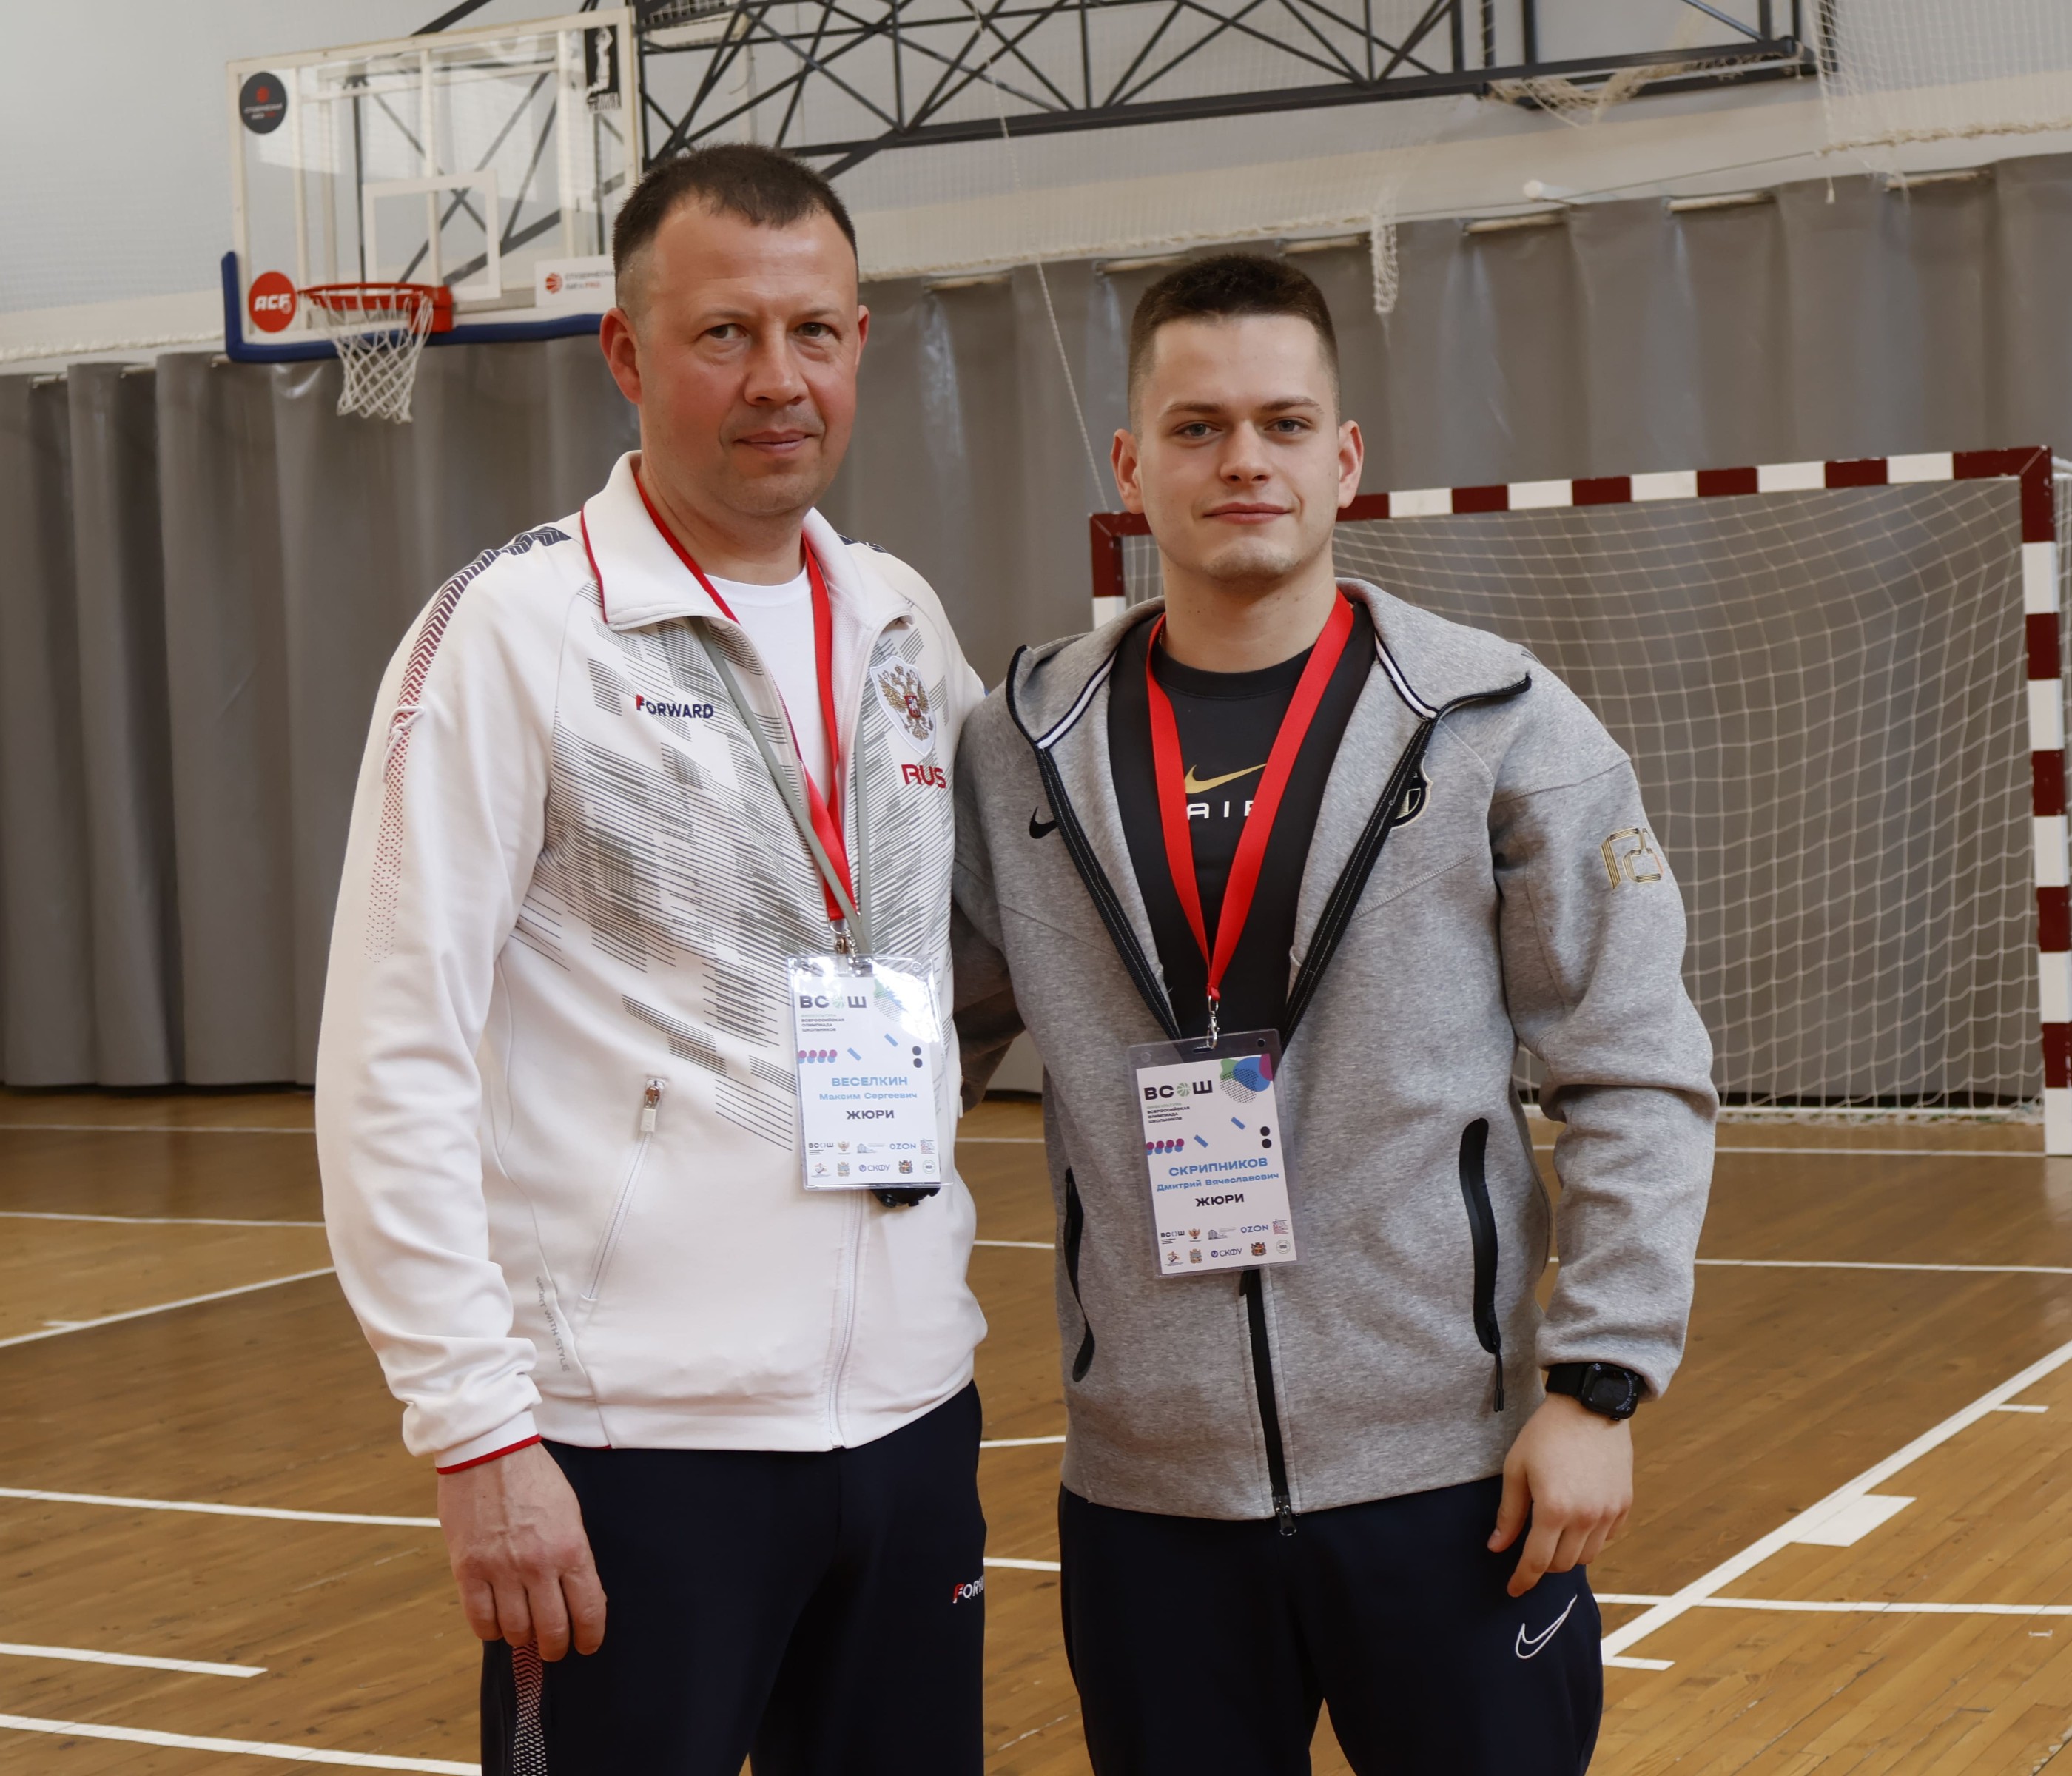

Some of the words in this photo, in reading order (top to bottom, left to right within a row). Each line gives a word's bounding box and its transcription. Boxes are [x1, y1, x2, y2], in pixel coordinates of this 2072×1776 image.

[636, 694, 714, 719] FORWARD
[901, 764, 946, 789] RUS
[831, 1077, 908, 1086] ВЕСЕЛКИН
[864, 1092, 918, 1100] Сергеевич
[846, 1109, 895, 1120] ЖЮРИ
[1168, 1157, 1268, 1177] СКРИПНИКОВ
[1156, 1180, 1202, 1192] Дмитрий
[1205, 1173, 1279, 1186] Вячеславович
[1195, 1194, 1245, 1208] ЖЮРИ
[1240, 1225, 1269, 1234] OZON
[1219, 1248, 1243, 1257] СКФУ
[535, 1276, 546, 1308] SPORT
[545, 1309, 559, 1336] WITH
[556, 1338, 570, 1372] STYLE
